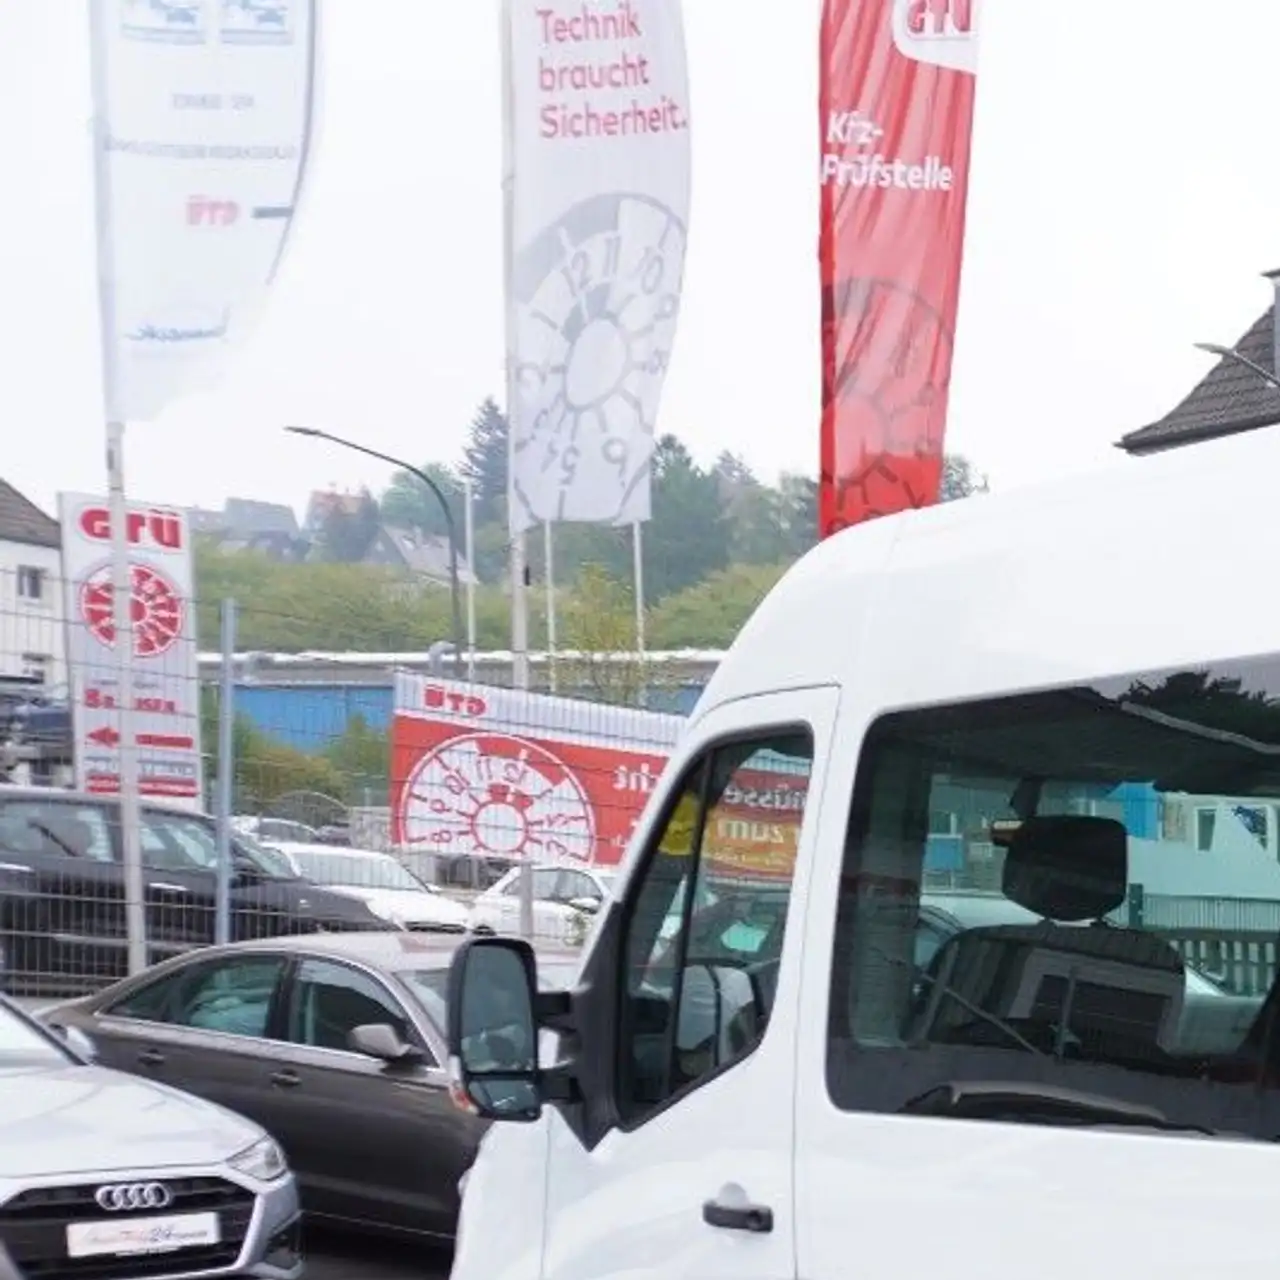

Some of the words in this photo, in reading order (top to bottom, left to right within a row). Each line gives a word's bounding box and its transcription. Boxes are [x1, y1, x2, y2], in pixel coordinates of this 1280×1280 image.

[536, 1, 642, 43] Technik
[539, 51, 649, 91] braucht
[539, 95, 688, 139] Sicherheit.
[820, 153, 954, 190] Prüfstelle
